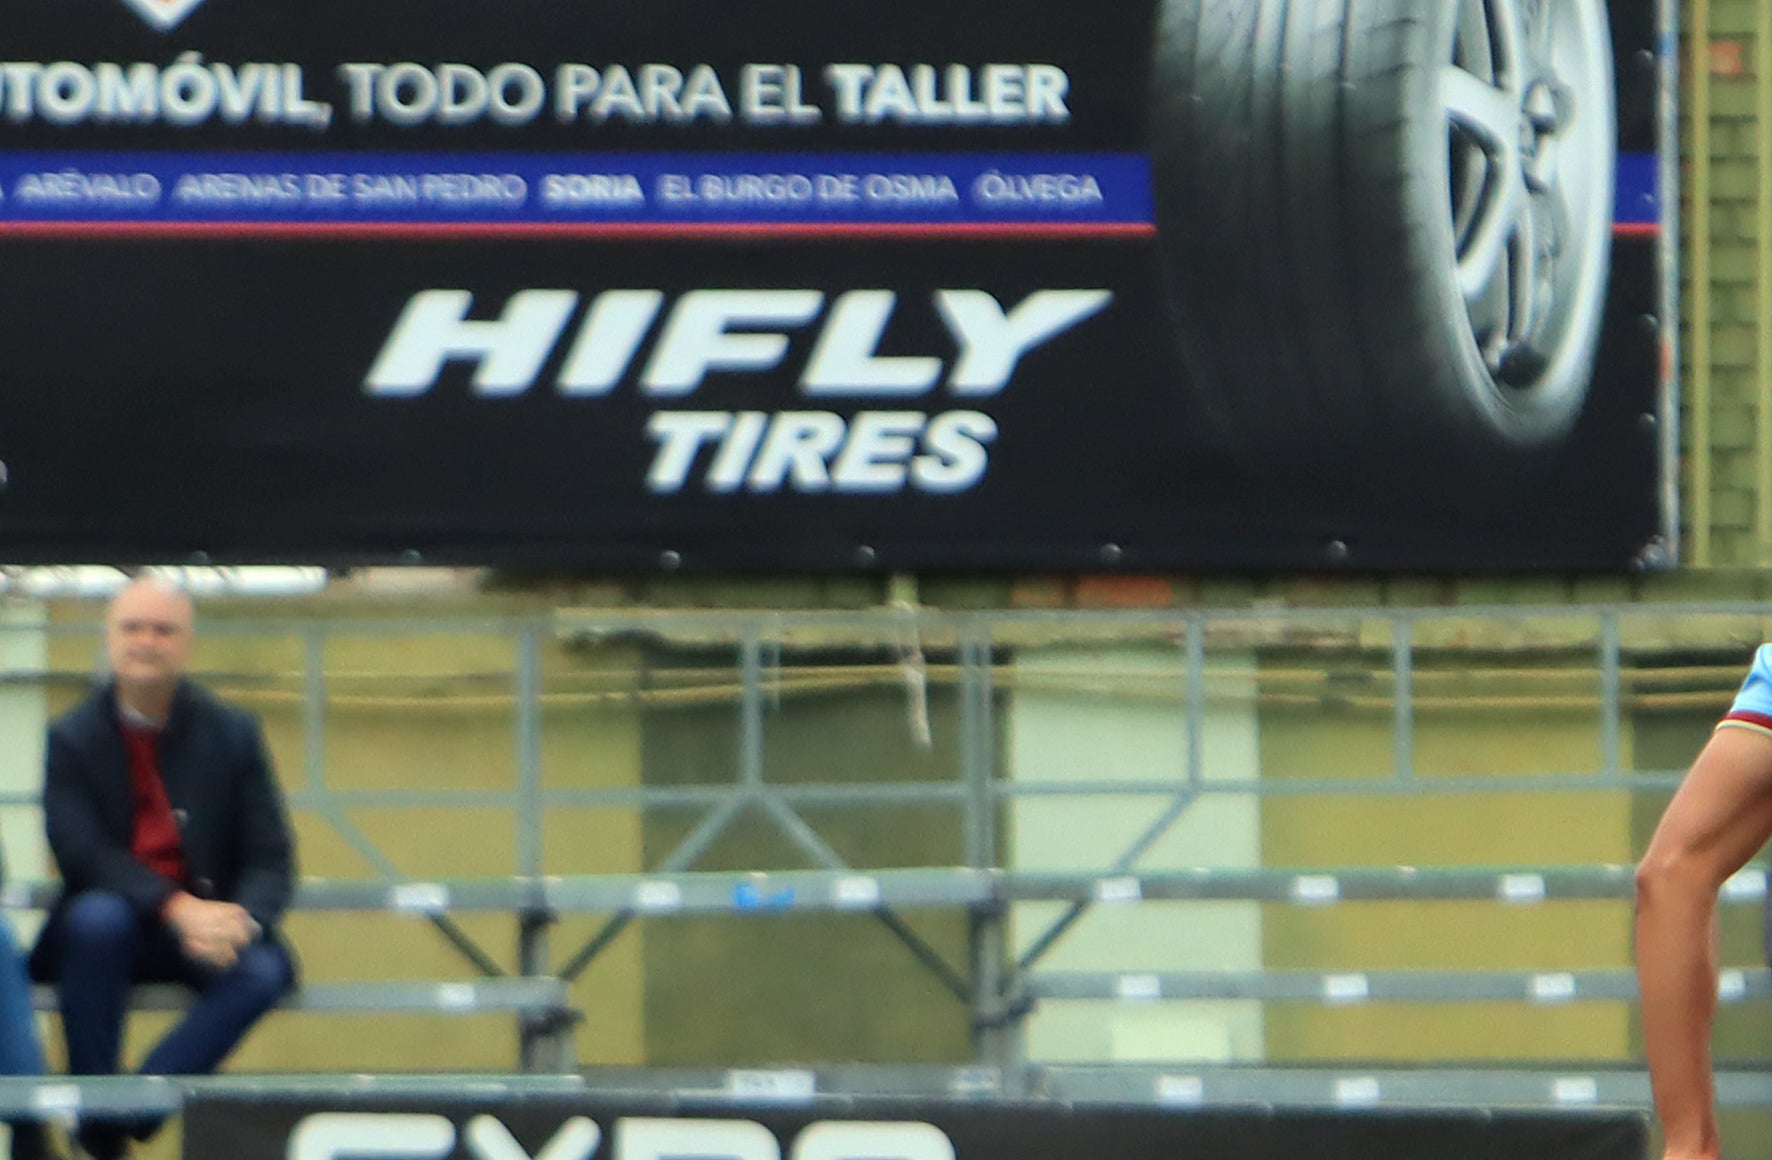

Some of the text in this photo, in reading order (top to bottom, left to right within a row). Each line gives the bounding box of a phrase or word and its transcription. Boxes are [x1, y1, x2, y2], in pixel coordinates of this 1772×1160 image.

[0, 50, 1072, 131] TOMÓVIL, TODO PARA EL TALLER
[13, 167, 1104, 206] ARÉVALO ARENAS DE SAN PEDRO SORIA EL BURGO DE OSMA ÓLVEGA
[362, 287, 1114, 398] HIFLY
[642, 409, 999, 494] TIRES
